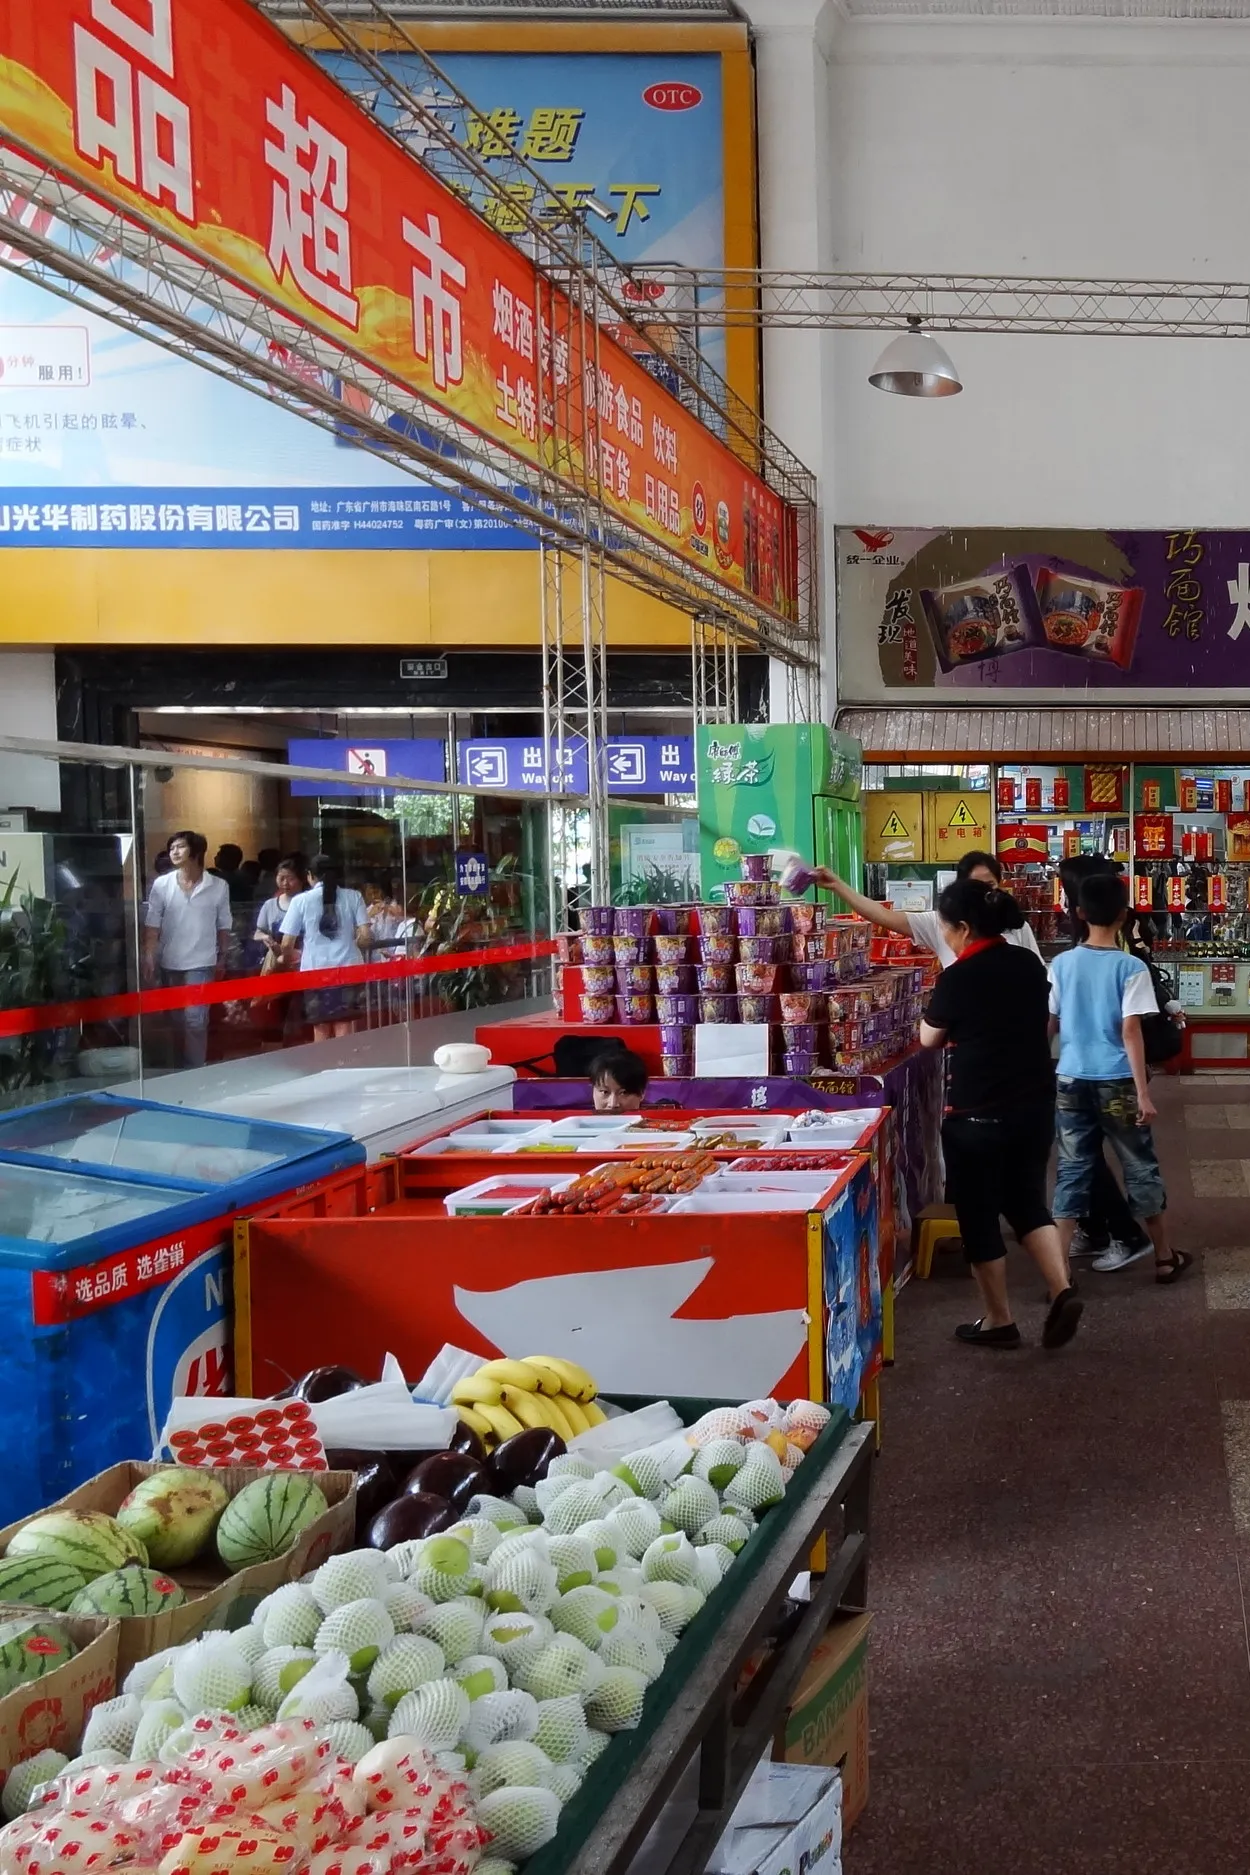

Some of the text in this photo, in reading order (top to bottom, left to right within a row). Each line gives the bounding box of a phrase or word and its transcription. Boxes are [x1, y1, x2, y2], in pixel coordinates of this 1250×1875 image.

[652, 88, 693, 104] OTC
[0, 412, 148, 431] 飞机引起的眩晕、
[652, 413, 677, 475] 饮料
[644, 473, 681, 536] 日用品
[846, 554, 900, 566] 统一企业
[523, 746, 573, 768] 出口
[522, 773, 548, 785] Way
[660, 770, 688, 783] Way
[938, 827, 983, 840] 配电箱
[75, 1241, 186, 1303] 选品质 选雀巢
